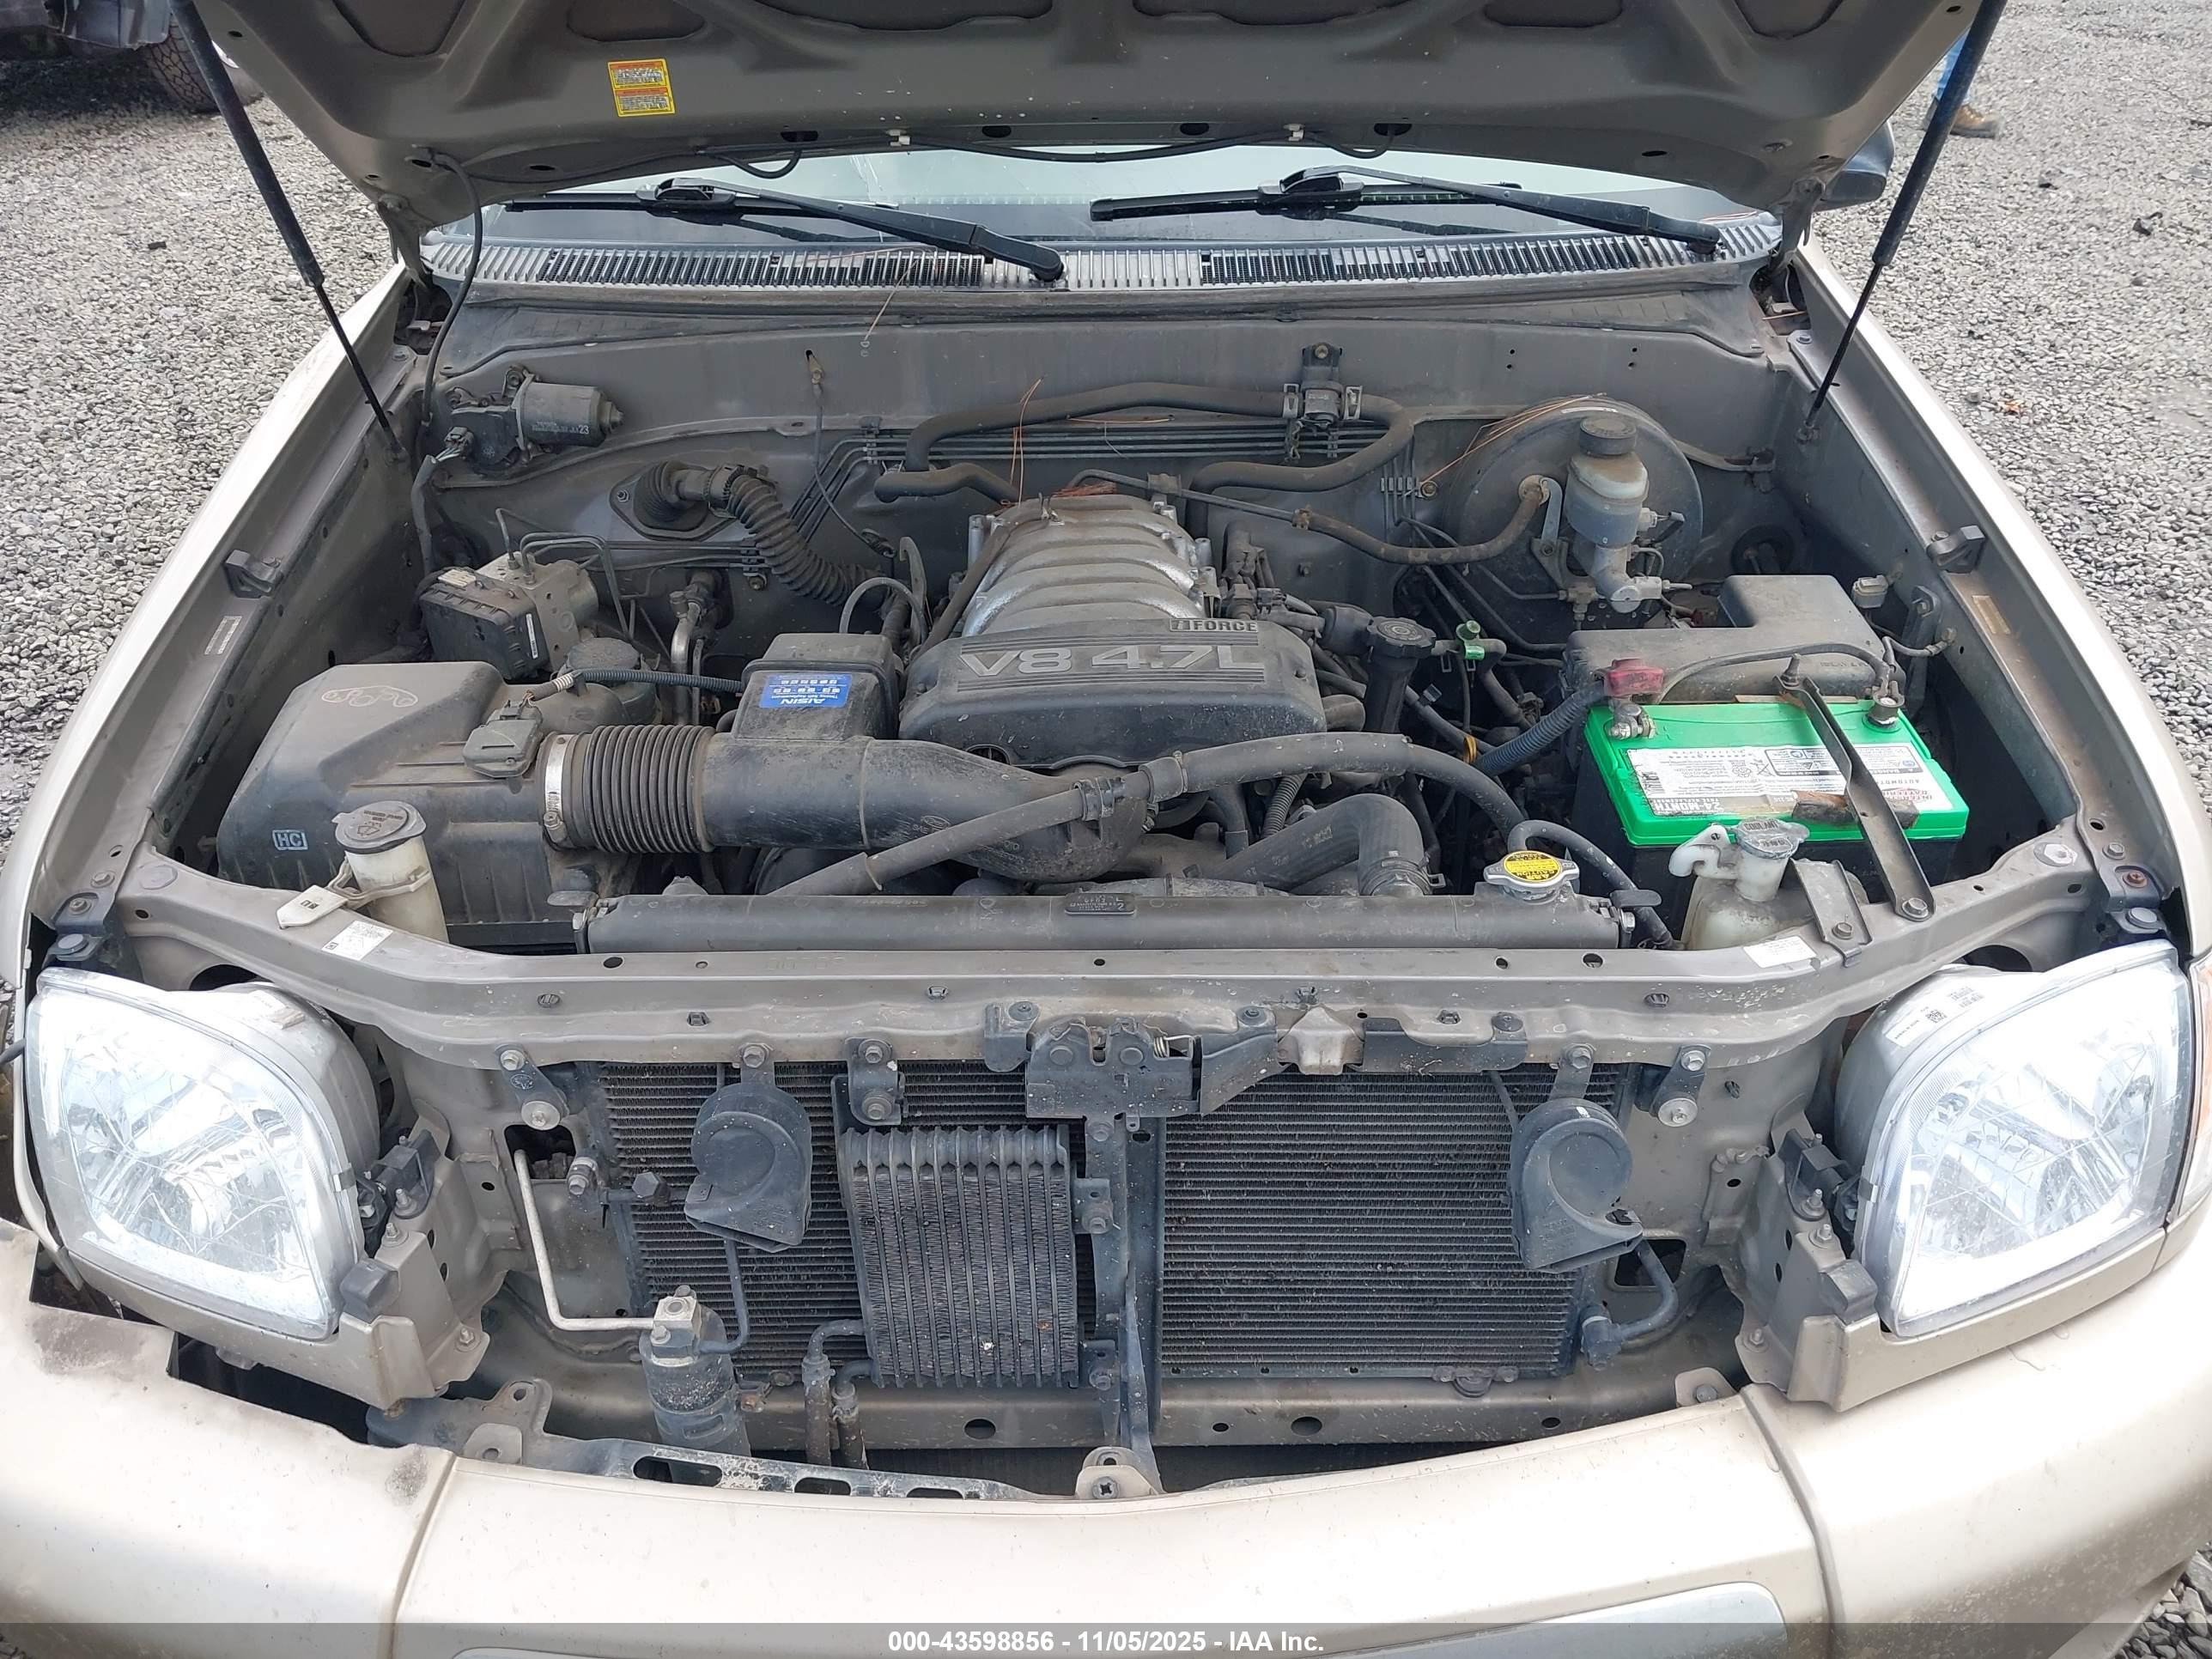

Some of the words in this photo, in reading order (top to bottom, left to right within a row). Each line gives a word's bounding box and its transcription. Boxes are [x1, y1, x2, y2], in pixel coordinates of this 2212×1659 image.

[959, 647, 1072, 678] V8
[1091, 645, 1266, 670] 4.7L
[1654, 802, 1721, 811] 24-MONTH
[1743, 821, 1779, 830] COOLANT
[276, 833, 302, 847] HC
